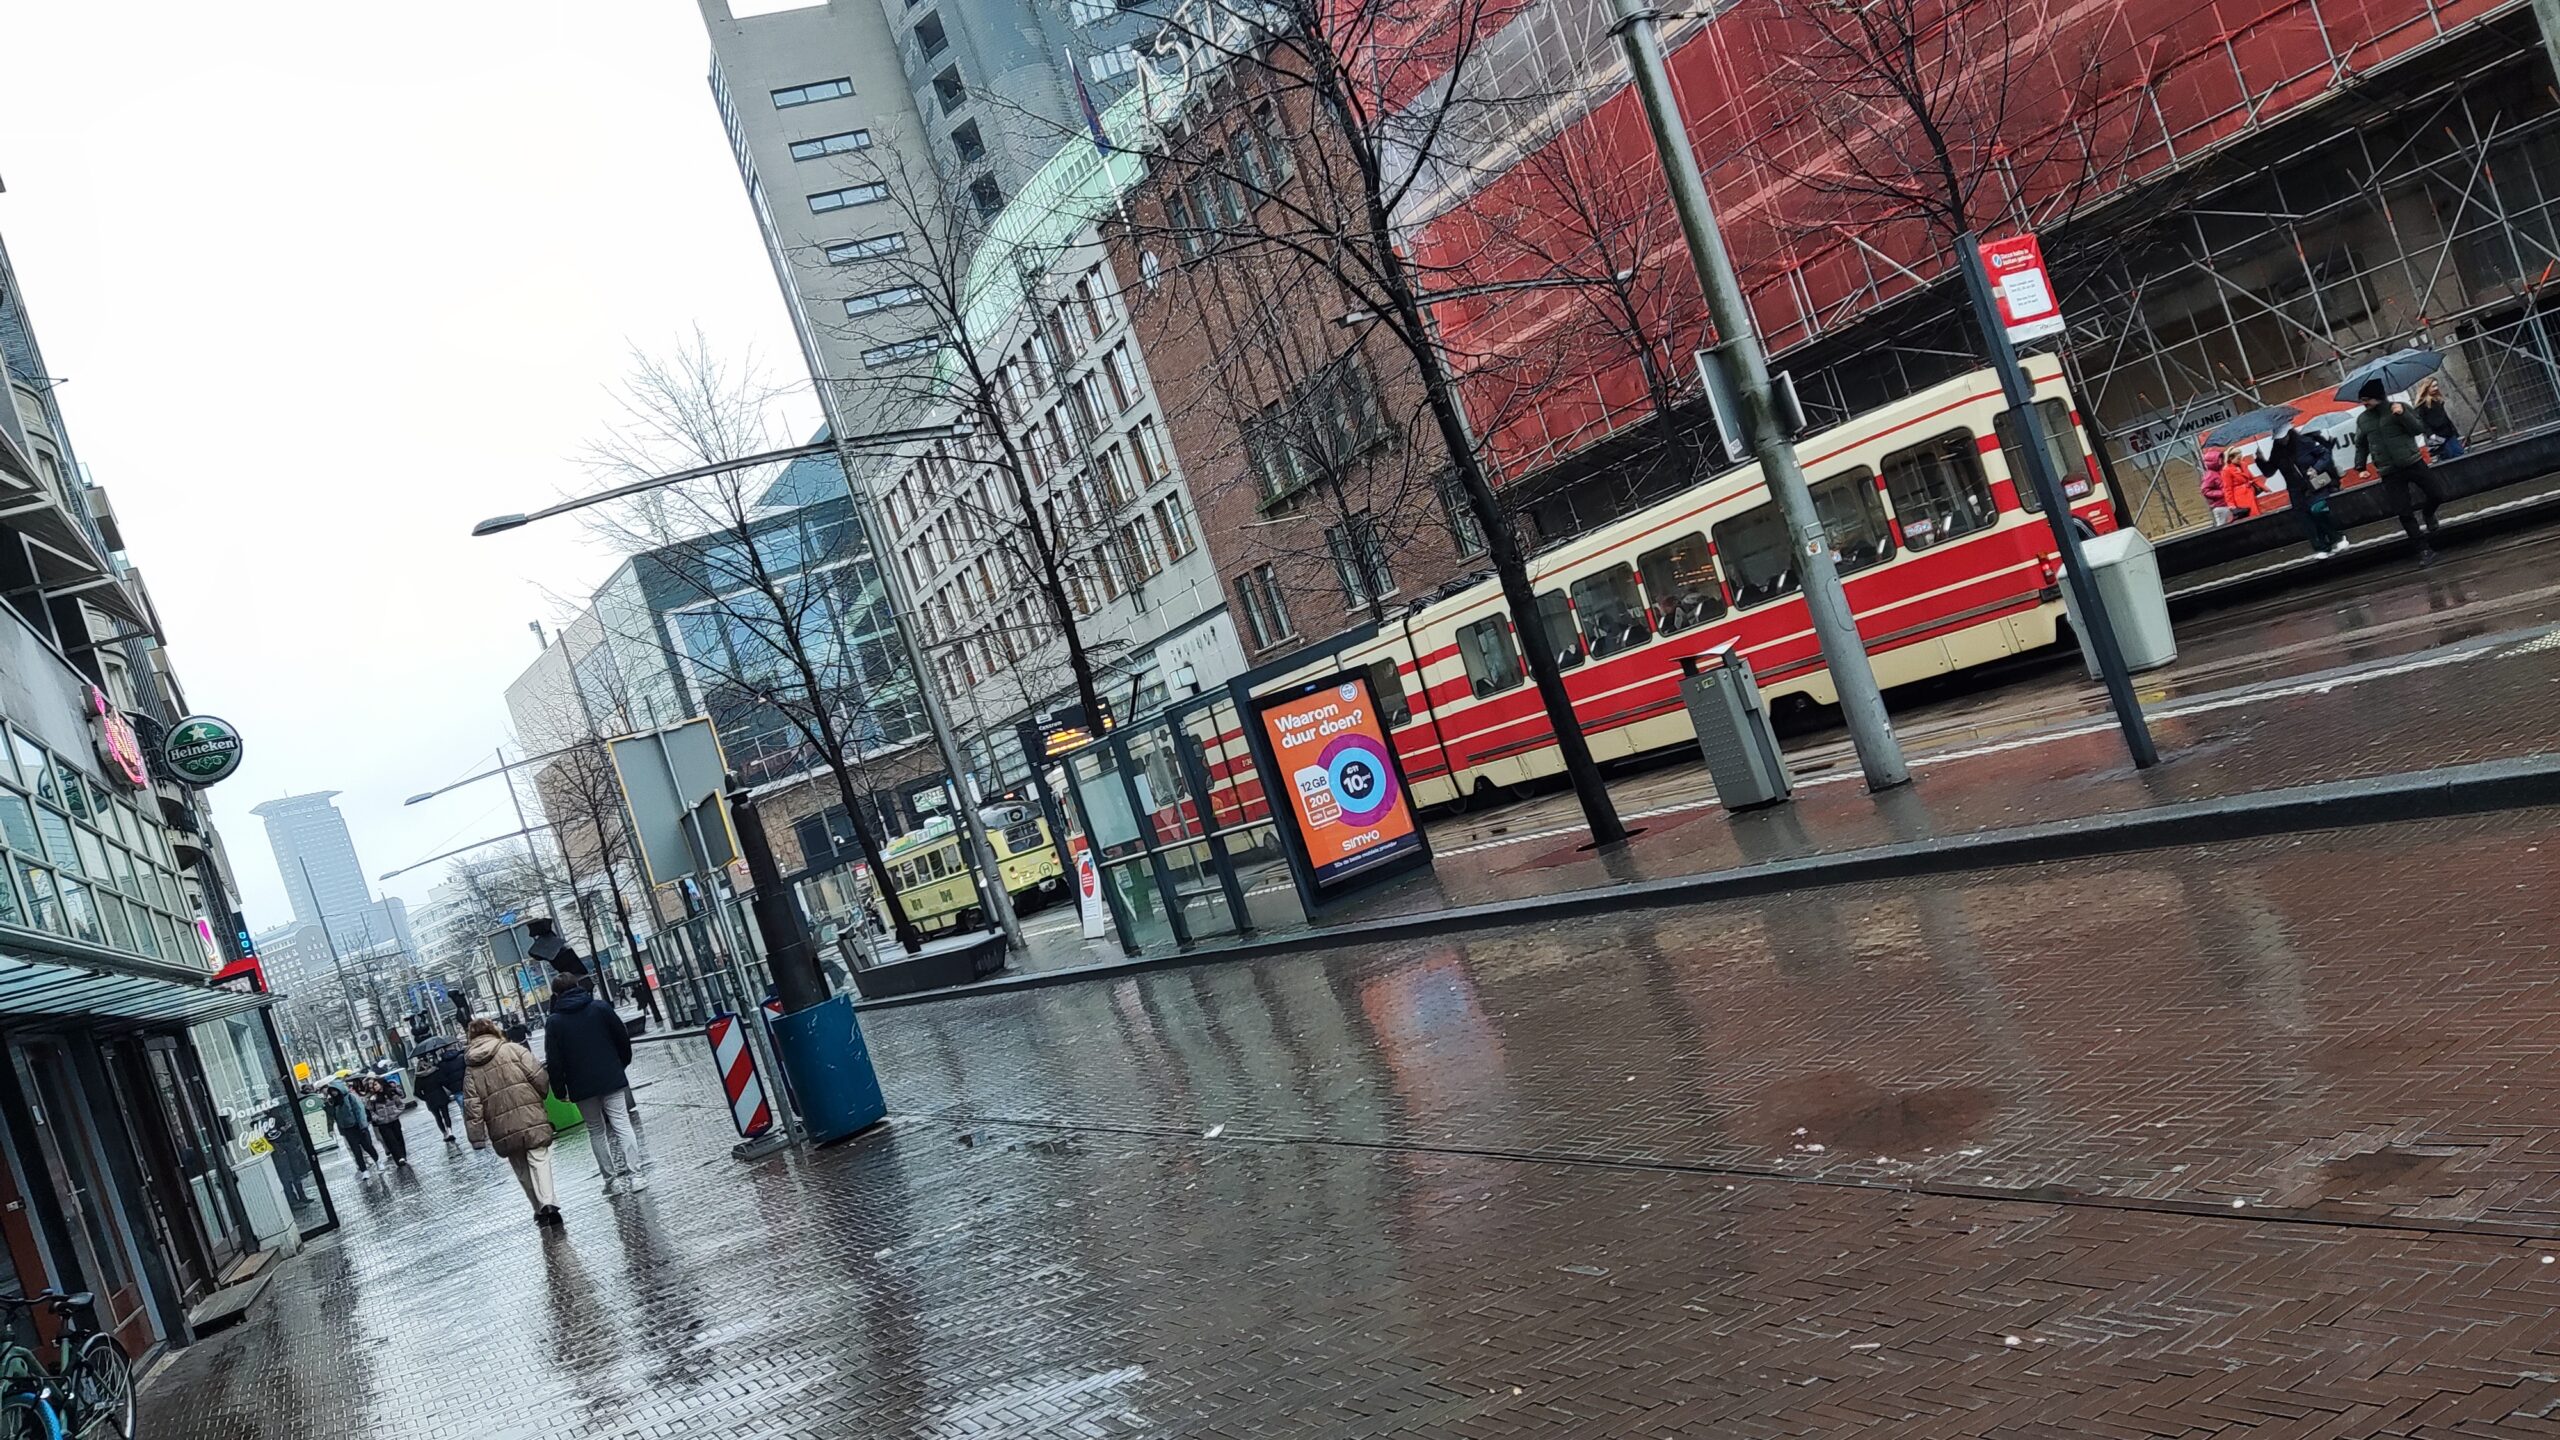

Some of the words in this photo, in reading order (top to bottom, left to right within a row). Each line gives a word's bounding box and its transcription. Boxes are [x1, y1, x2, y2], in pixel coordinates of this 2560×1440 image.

[1274, 703, 1339, 732] Waarom
[1281, 727, 1317, 749] duur
[1319, 709, 1363, 736] doen?
[170, 739, 235, 761] Heineken
[1309, 792, 1331, 809] 200
[218, 1098, 280, 1122] Donuts
[238, 1117, 276, 1150] Coffee
